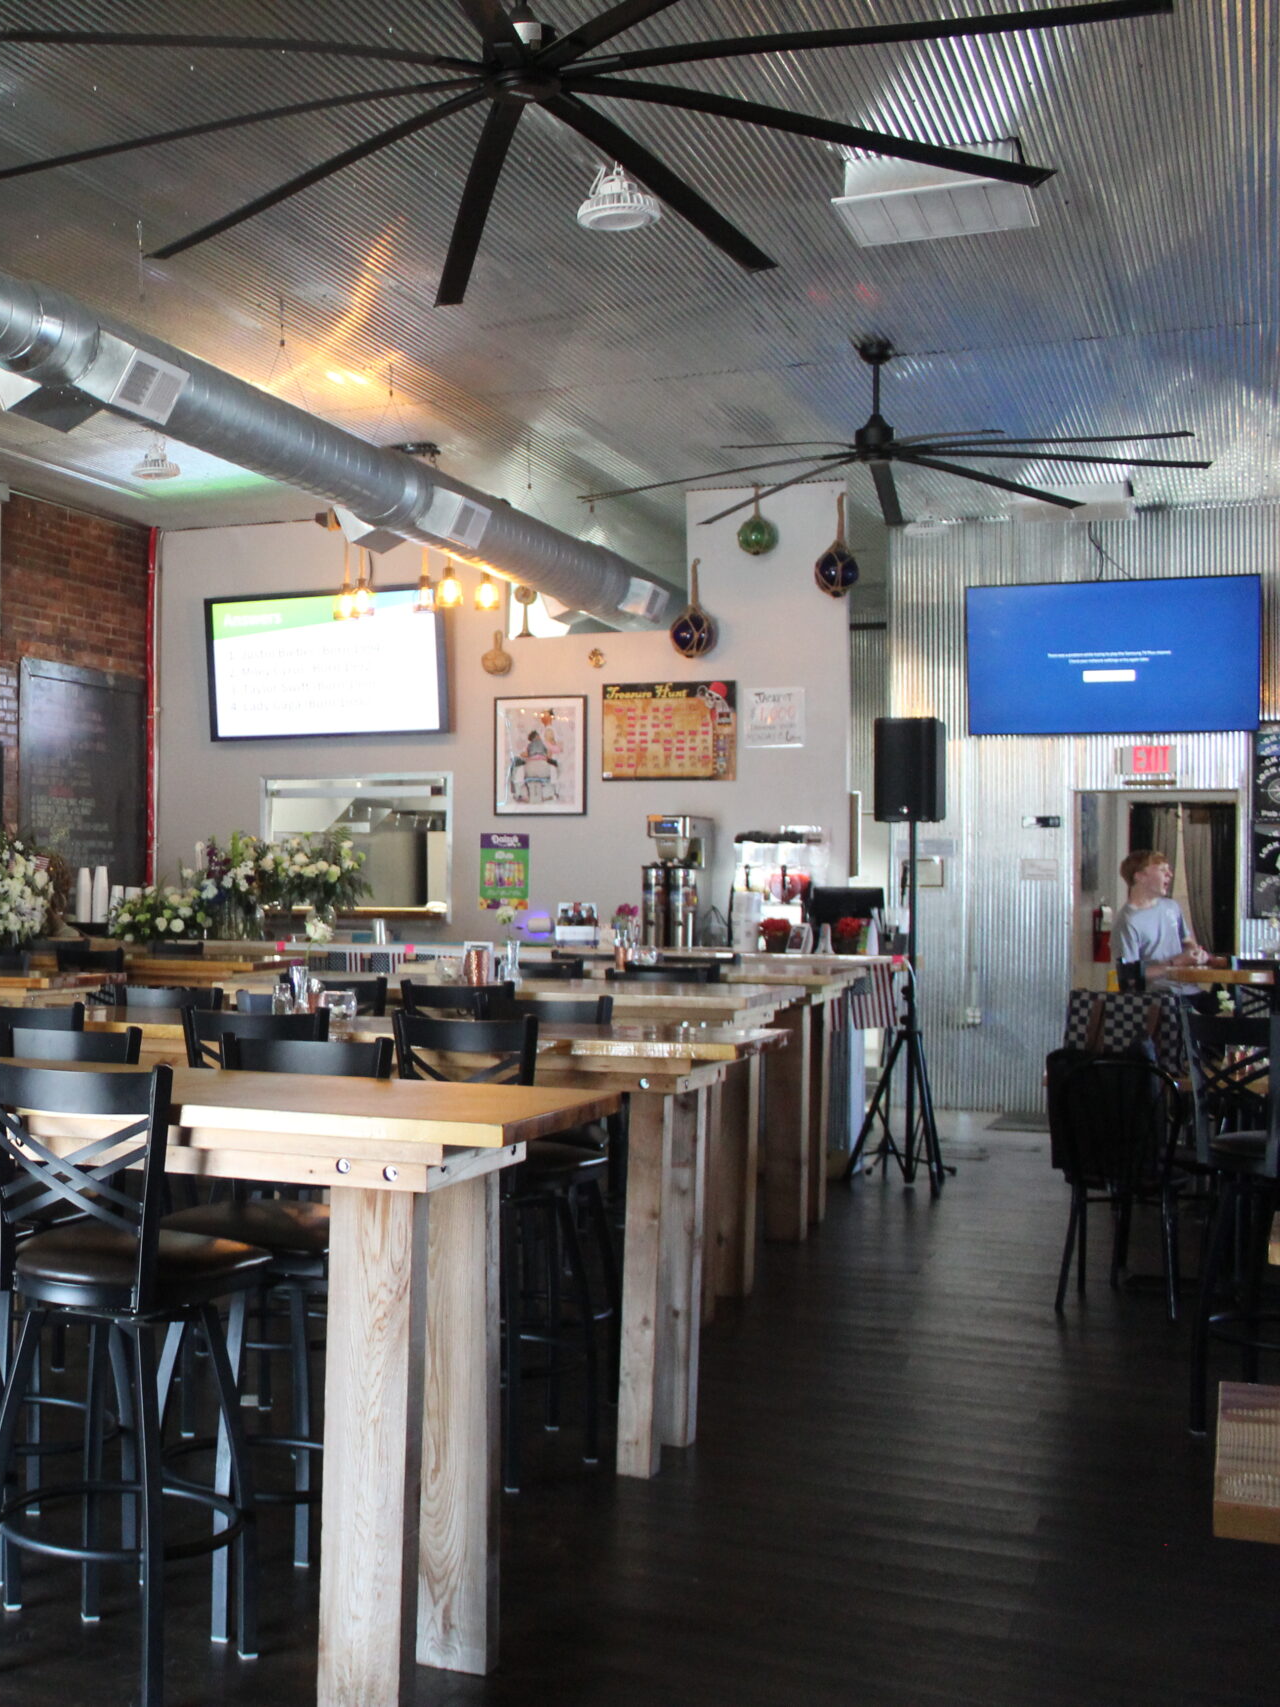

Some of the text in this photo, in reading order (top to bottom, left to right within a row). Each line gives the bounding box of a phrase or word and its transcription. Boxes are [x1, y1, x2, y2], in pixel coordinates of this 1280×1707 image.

[223, 612, 282, 627] Answers
[605, 682, 690, 699] Treasure Hunt
[1133, 745, 1171, 774] EXIT
